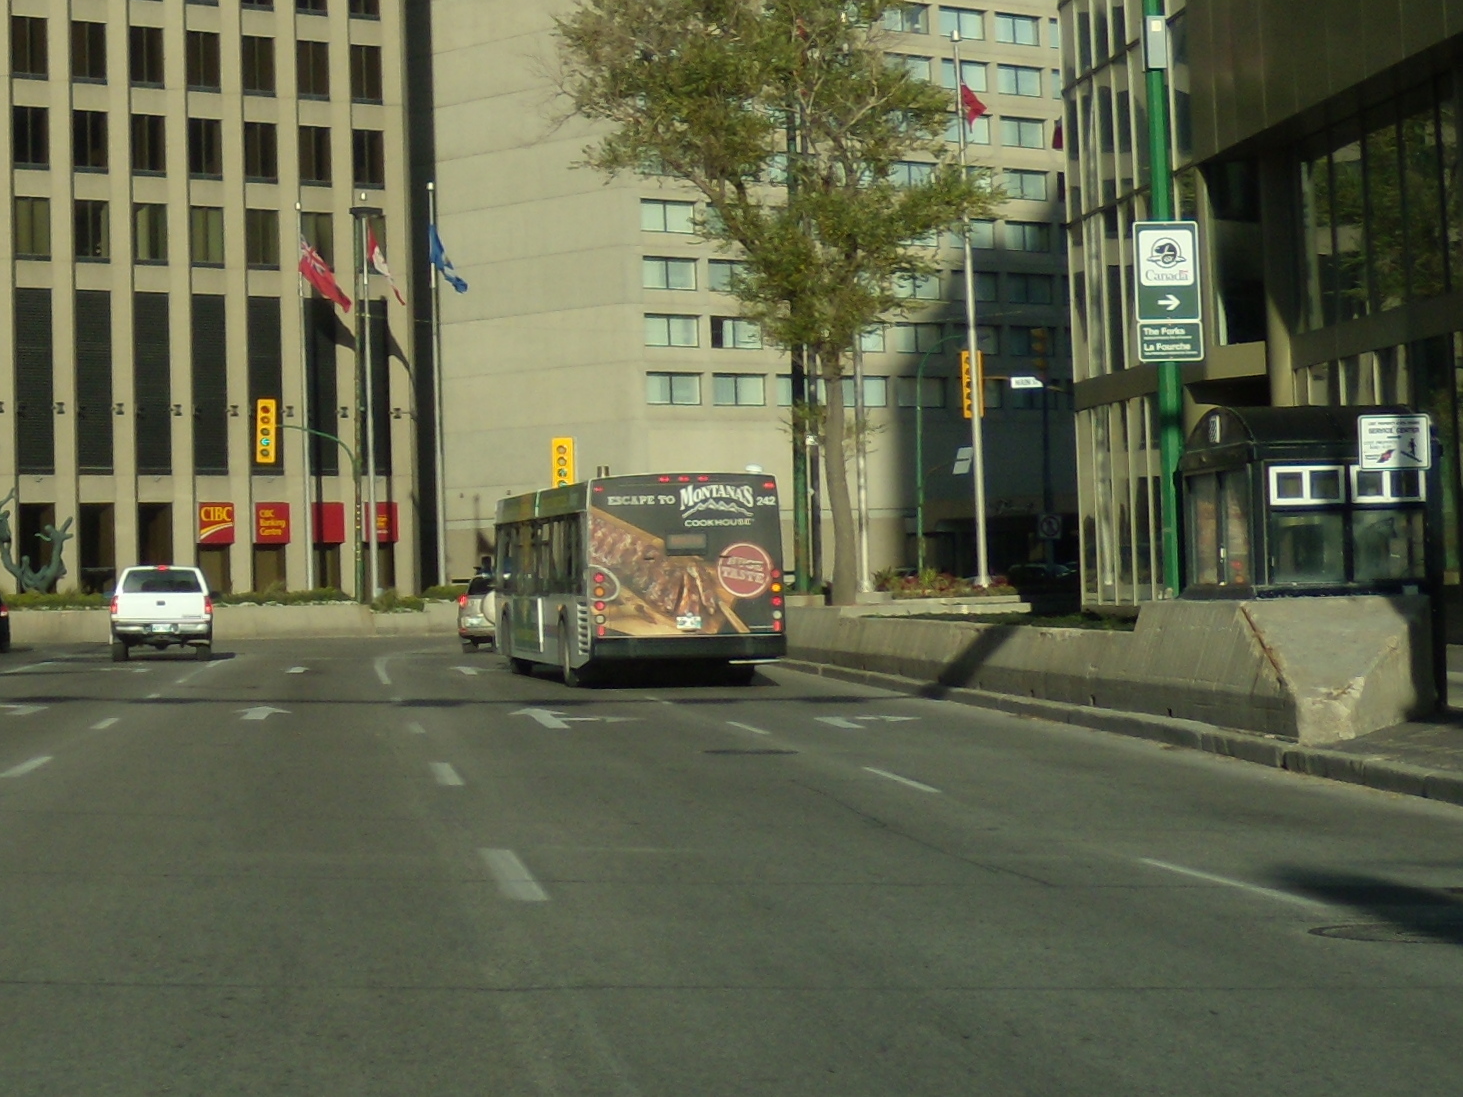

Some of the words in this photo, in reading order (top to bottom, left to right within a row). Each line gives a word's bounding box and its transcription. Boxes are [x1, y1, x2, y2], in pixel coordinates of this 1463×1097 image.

[1145, 269, 1189, 282] Canada
[1142, 326, 1160, 336] The
[1161, 326, 1186, 336] Forks
[1143, 342, 1155, 351] La
[607, 495, 655, 506] ESCAPE
[657, 495, 676, 505] TO
[756, 496, 776, 506] 242
[200, 506, 233, 522] CIBC
